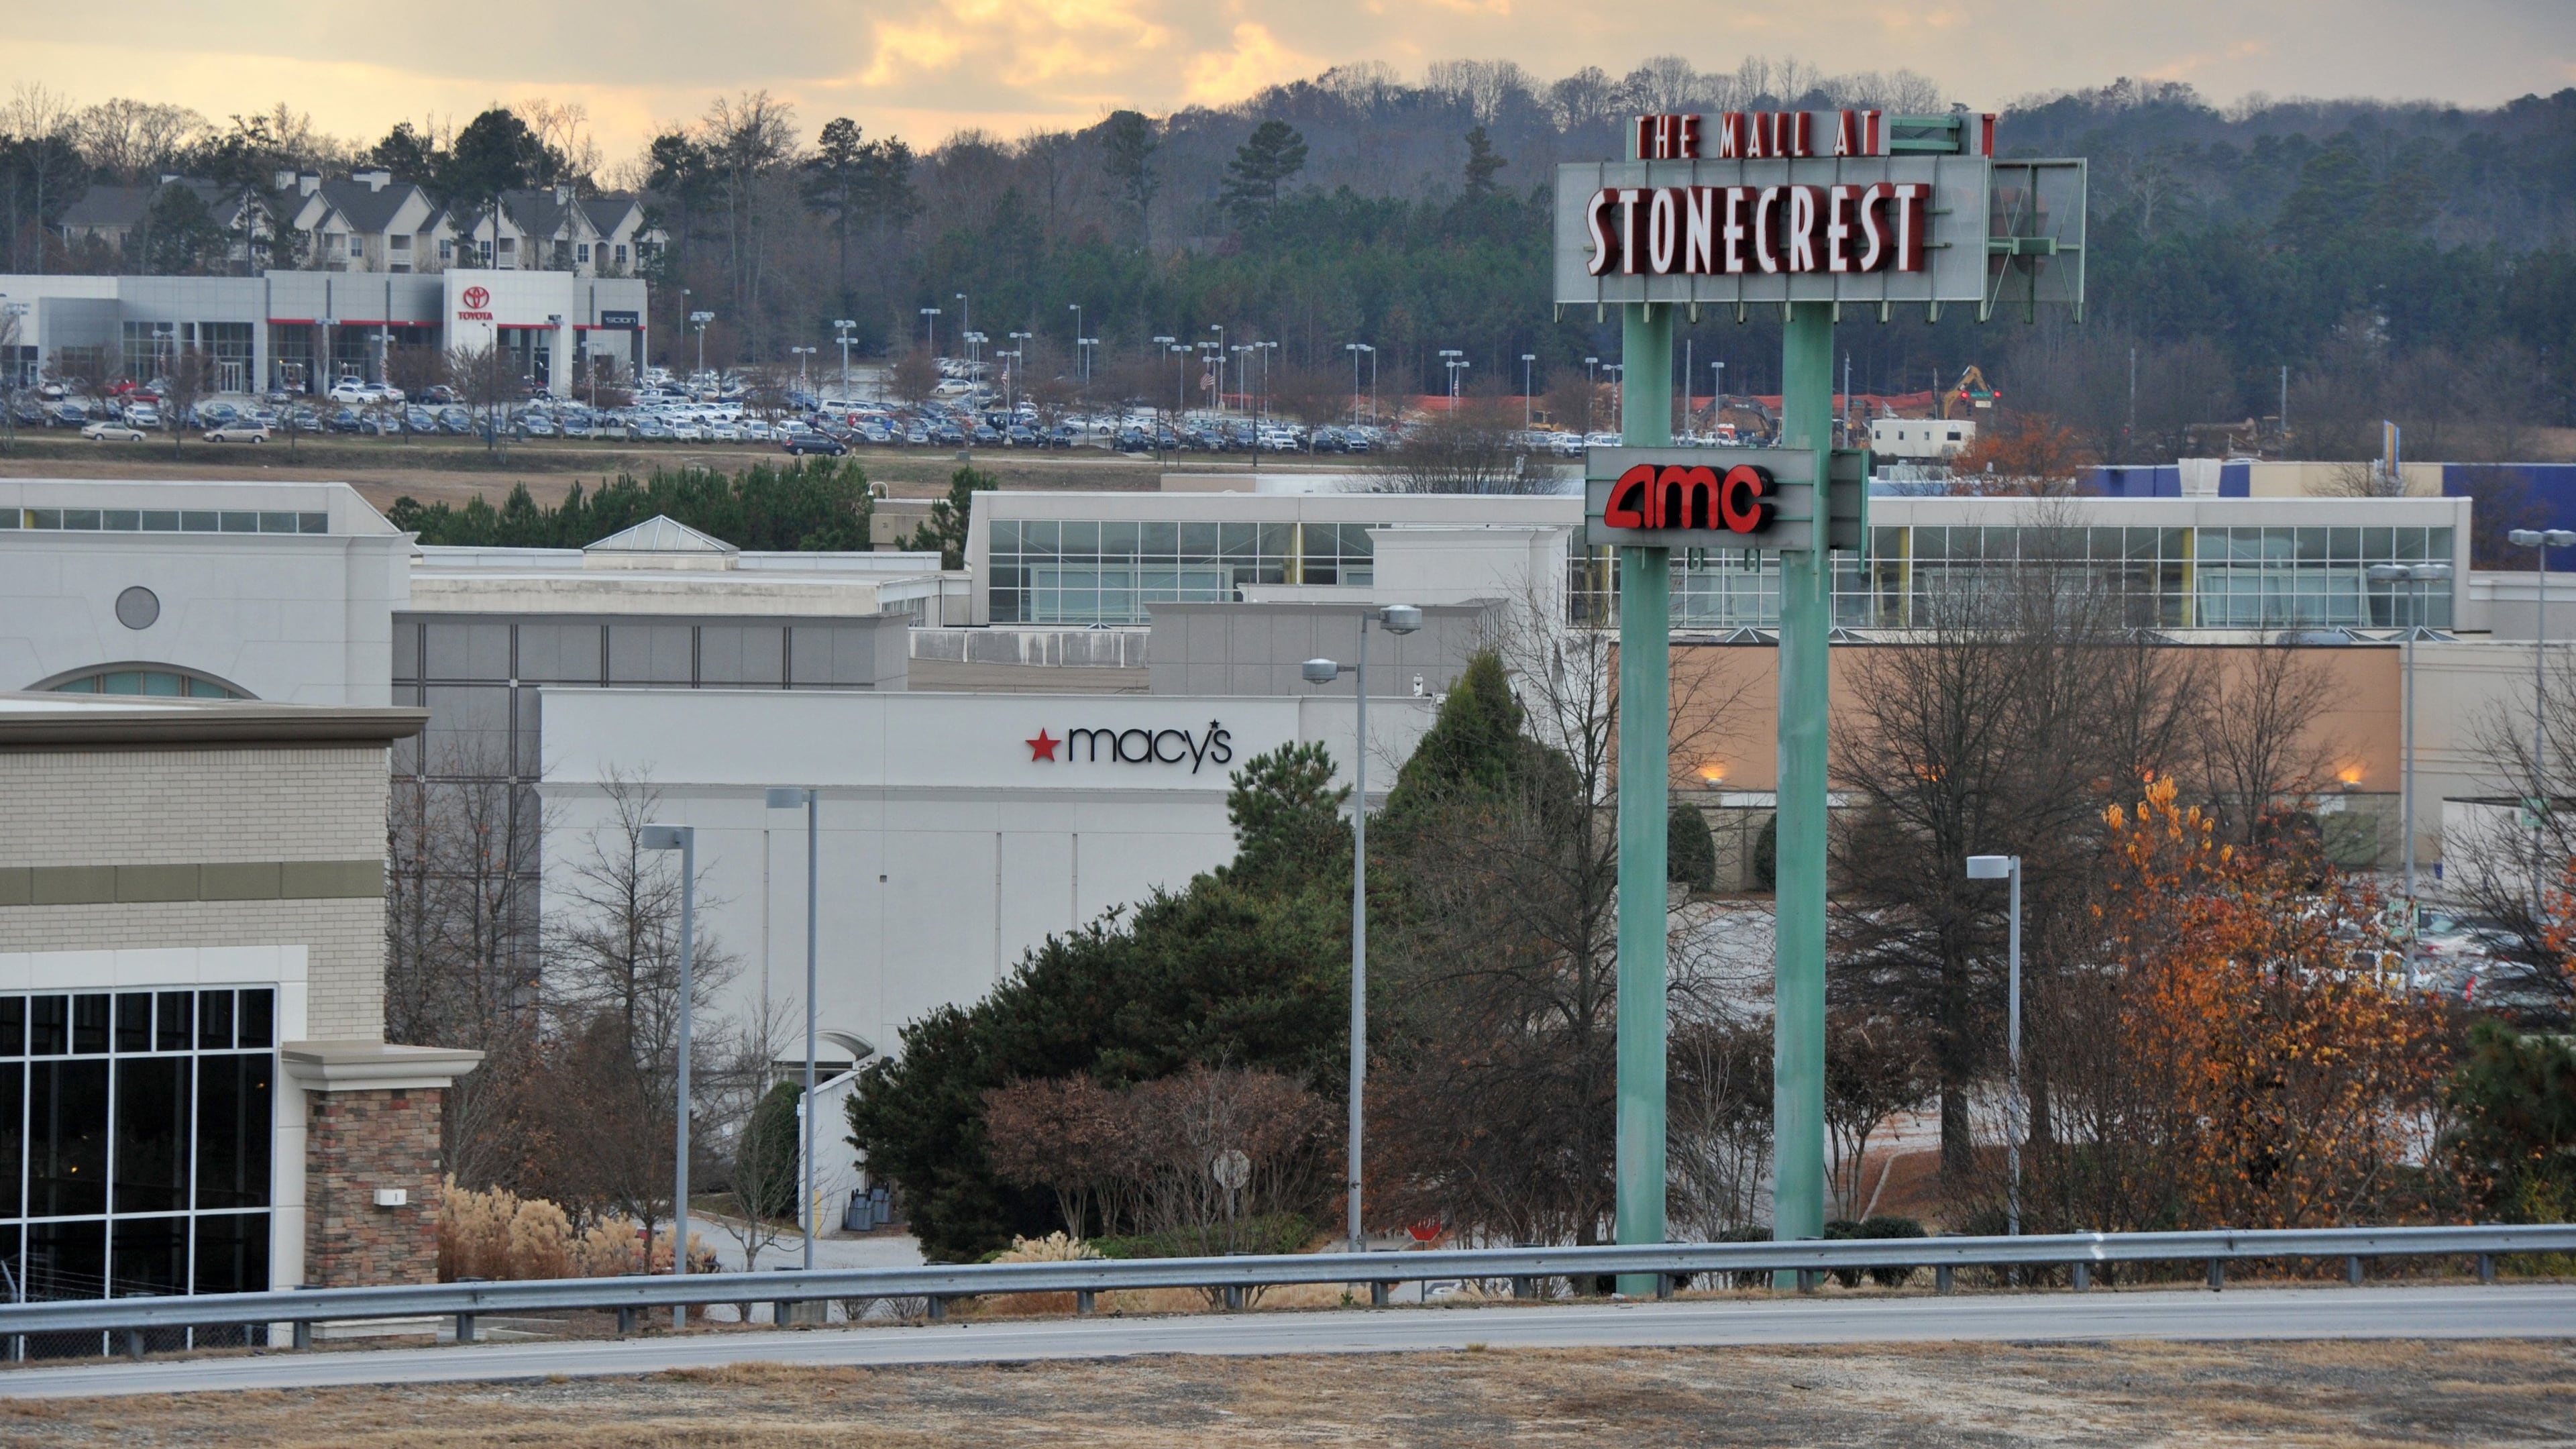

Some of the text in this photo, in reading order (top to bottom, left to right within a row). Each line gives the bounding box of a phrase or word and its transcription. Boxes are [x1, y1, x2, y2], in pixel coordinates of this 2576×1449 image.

[1635, 109, 1881, 159] THE MALL AT
[1587, 182, 1929, 276] STONECREST
[458, 311, 493, 320] TOYOTA
[1069, 718, 1232, 774] macy's
